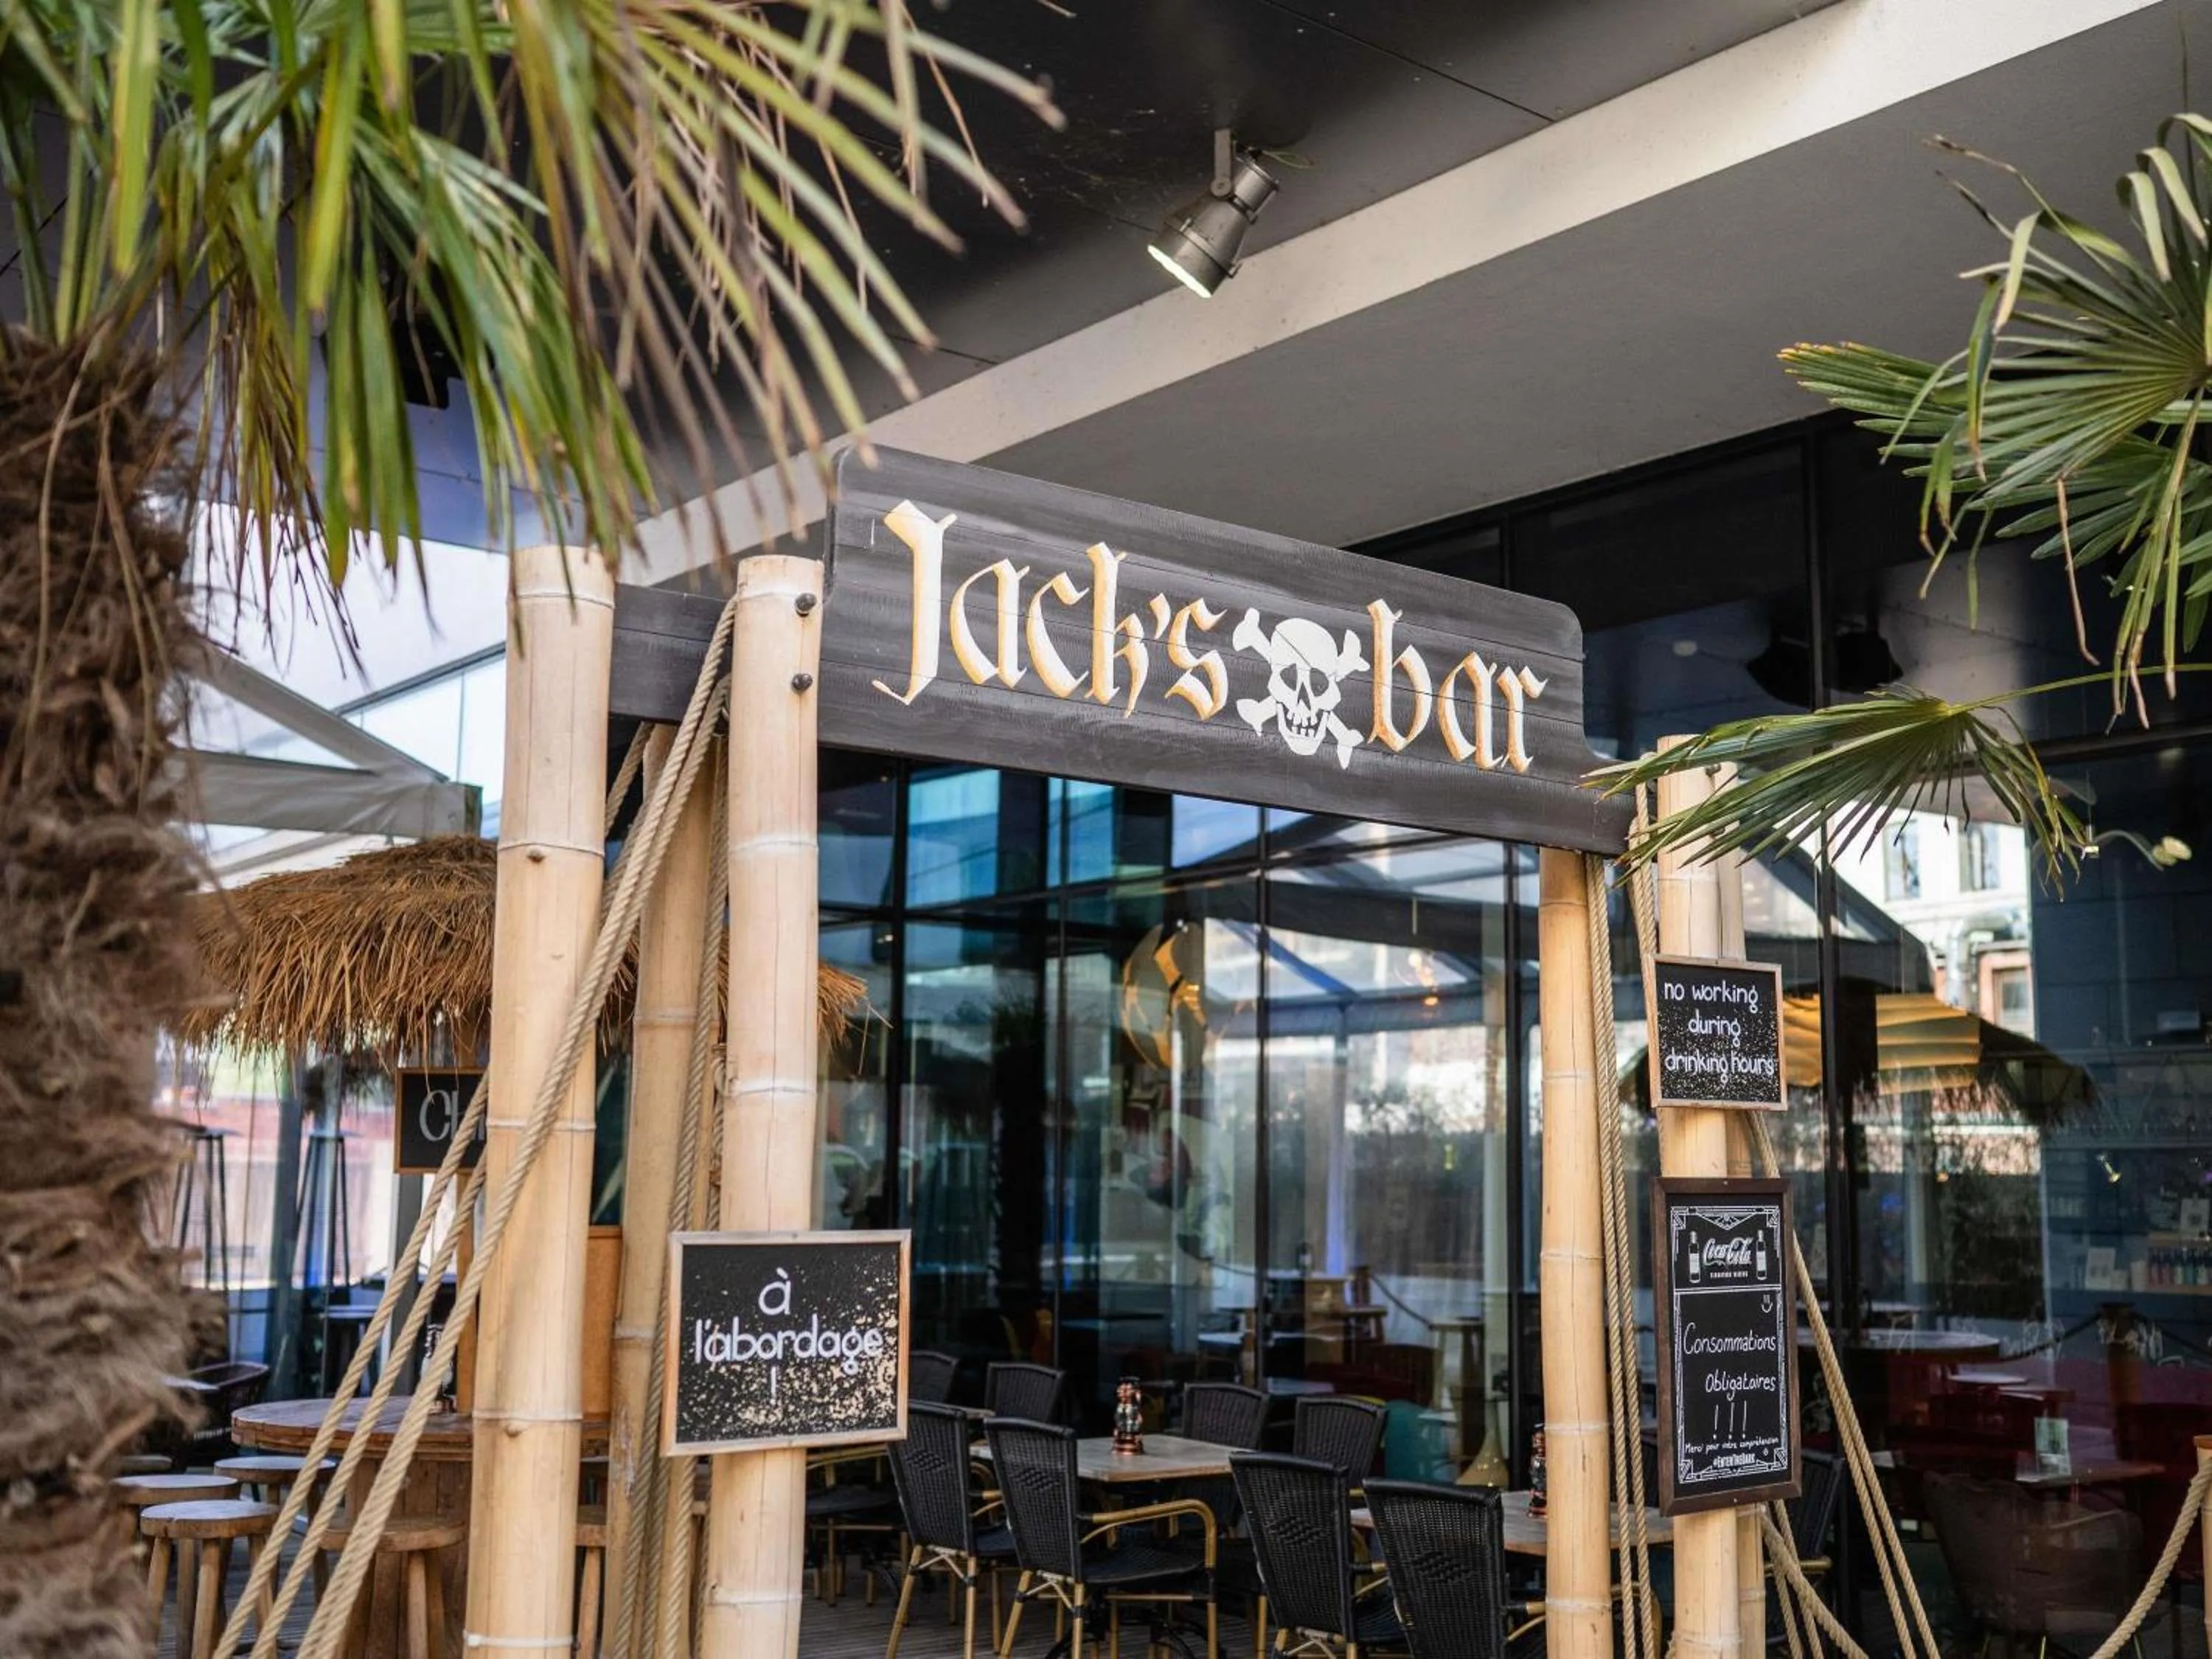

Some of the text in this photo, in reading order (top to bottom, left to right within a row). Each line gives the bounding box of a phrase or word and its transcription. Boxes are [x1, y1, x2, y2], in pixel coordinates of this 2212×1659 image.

[872, 499, 1548, 772] Jack's bar
[1664, 979, 1759, 1014] no working
[1688, 1009, 1741, 1048] during
[1665, 1047, 1775, 1084] drinking hours
[758, 1267, 792, 1316] à
[695, 1313, 885, 1375] l'abordage
[1683, 1323, 1776, 1354] Consommations
[1705, 1368, 1777, 1401] Obligatoires
